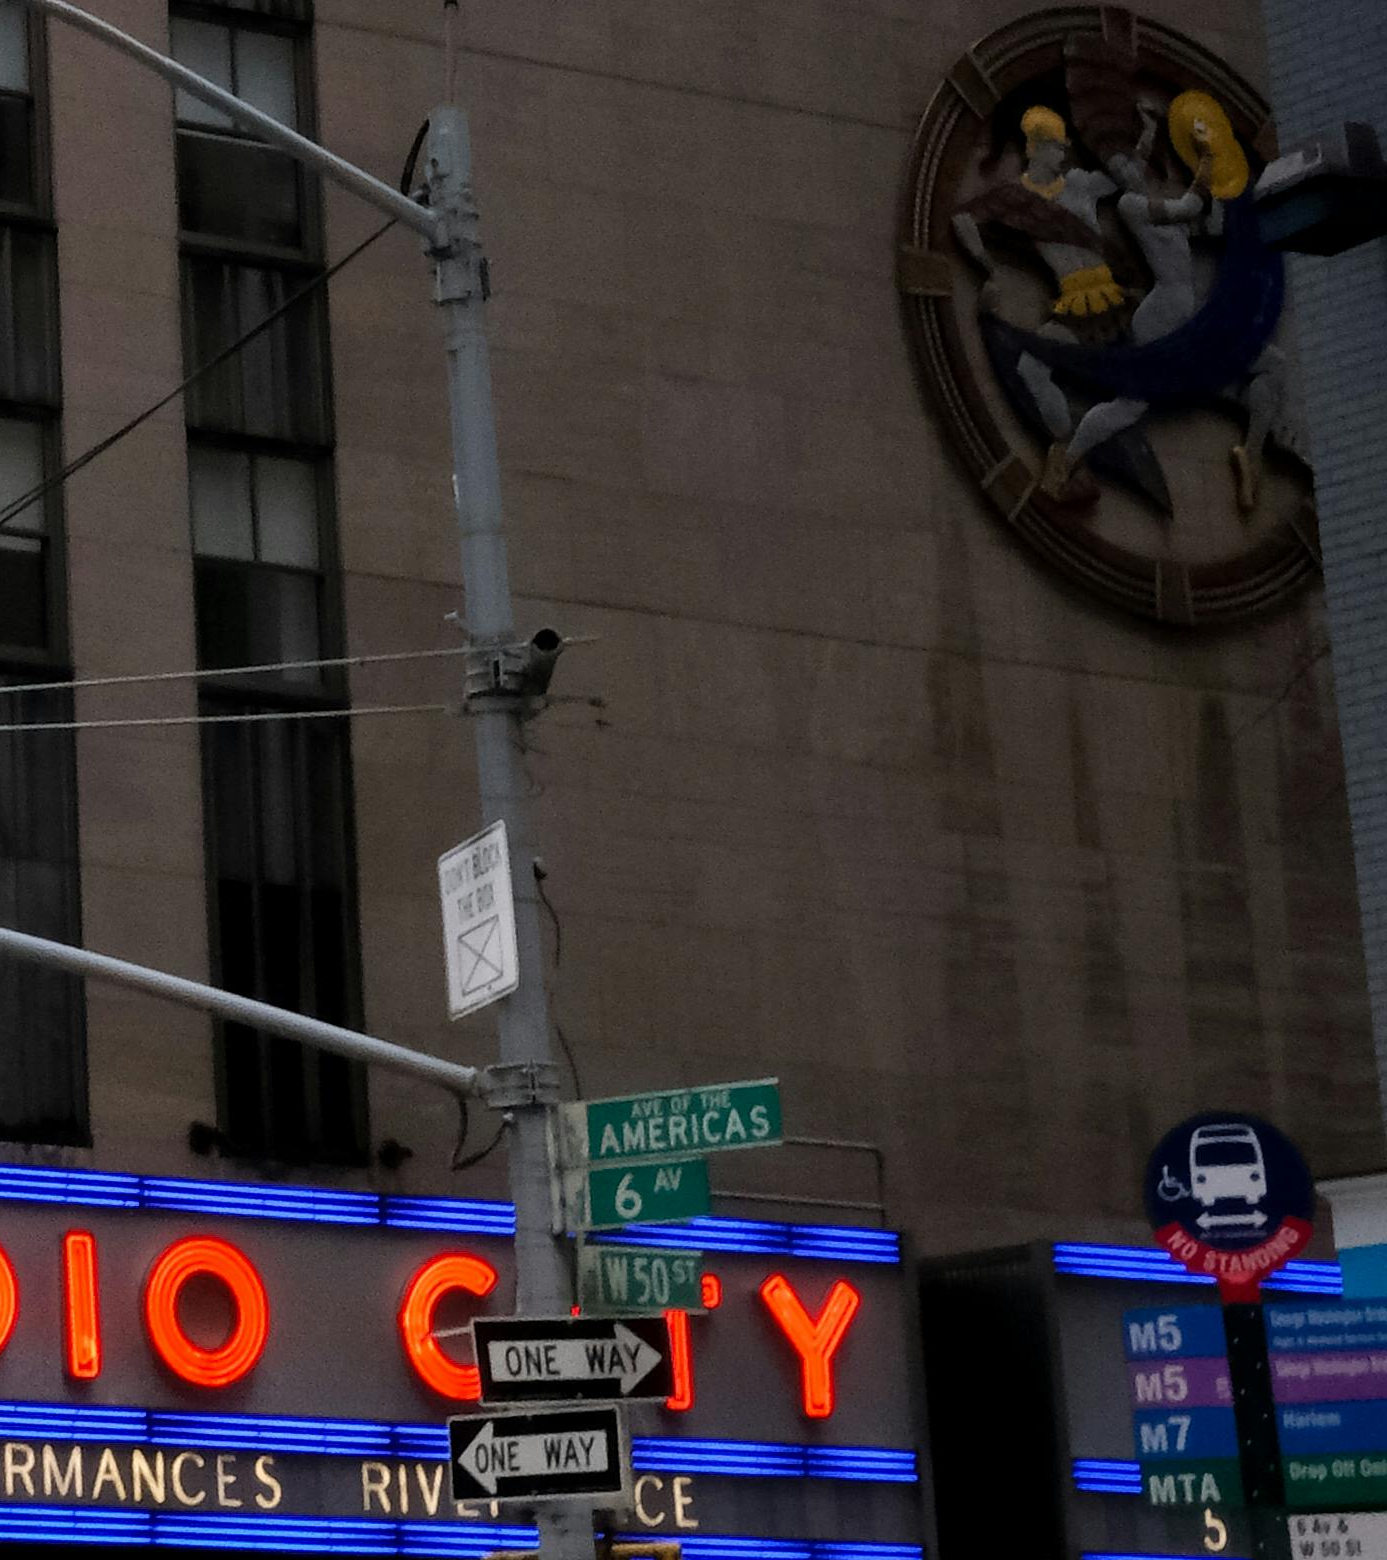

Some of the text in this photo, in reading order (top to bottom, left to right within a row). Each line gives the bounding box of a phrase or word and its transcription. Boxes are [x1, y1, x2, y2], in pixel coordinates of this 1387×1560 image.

[631, 1089, 731, 1119] AVE OF THE
[600, 1105, 770, 1156] AMERICAS
[615, 1167, 682, 1219] 6 AV
[1167, 1225, 1300, 1273] NO STANDING
[606, 1257, 695, 1305] W 50 ST
[1129, 1314, 1182, 1352] M5
[505, 1343, 640, 1377] ONE WAY
[1135, 1364, 1188, 1403] M5
[1140, 1416, 1191, 1453] M7
[475, 1437, 594, 1474] ONE WAY
[1149, 1473, 1221, 1506] MTA
